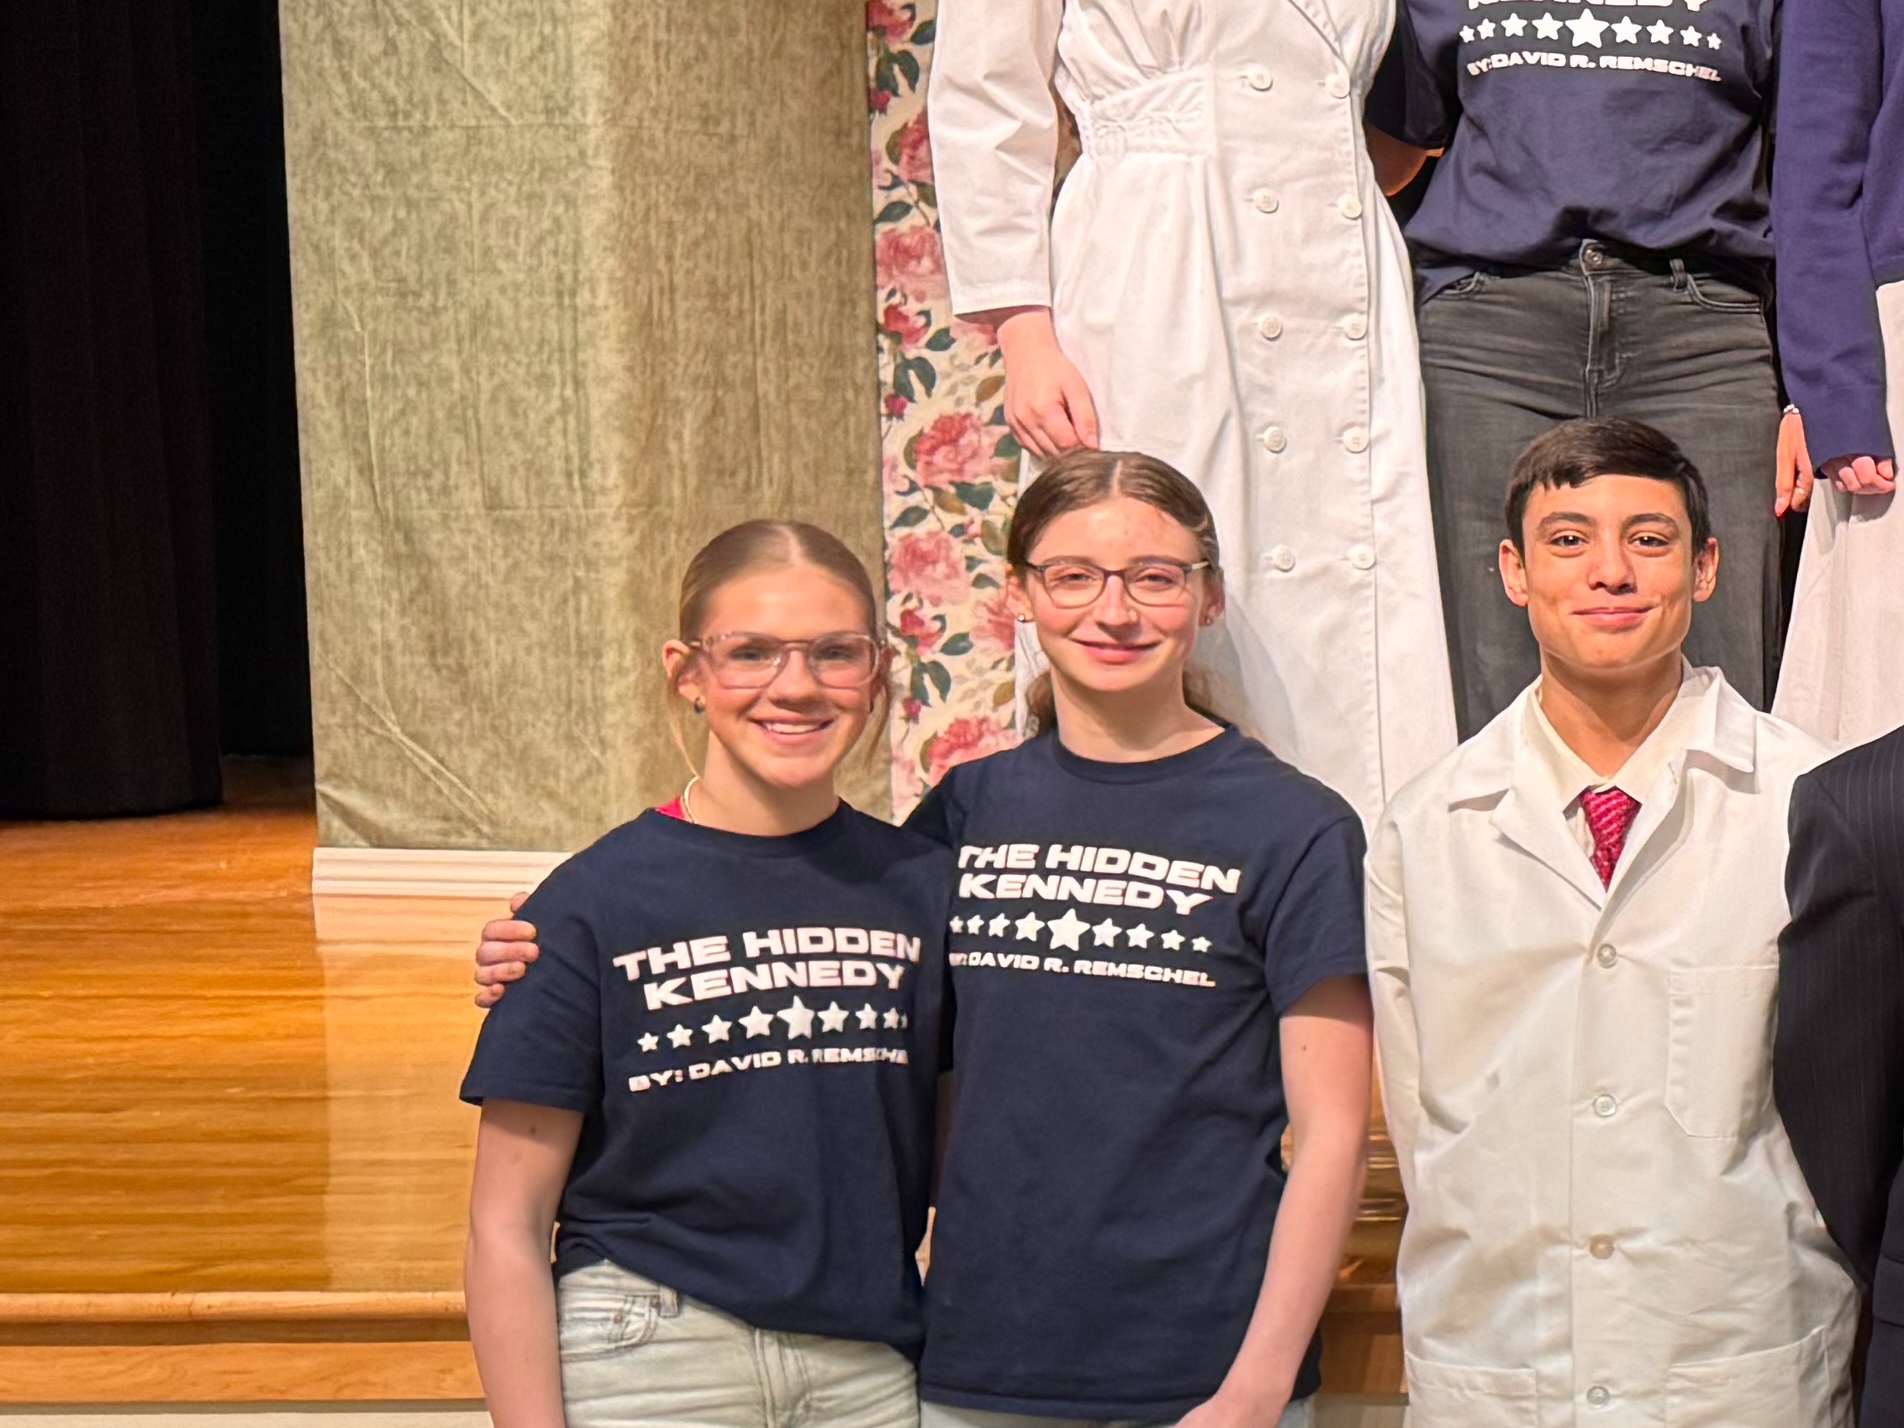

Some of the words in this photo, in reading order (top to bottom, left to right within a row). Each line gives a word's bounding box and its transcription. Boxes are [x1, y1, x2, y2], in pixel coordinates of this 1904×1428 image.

[1490, 50, 1567, 68] DAVID
[1570, 54, 1597, 69] R.
[957, 843, 1041, 870] THE
[1044, 843, 1242, 895] HIDDEN
[957, 872, 1214, 917] KENNEDY
[612, 935, 732, 982] THE
[742, 927, 921, 964] HIDDEN
[967, 951, 1040, 971] DAVID
[1043, 957, 1070, 974] R.
[1073, 959, 1217, 988] REMSCHEL
[643, 959, 905, 1012] KENNEDY
[628, 1069, 684, 1093] BY:
[688, 1051, 782, 1080] DAVID
